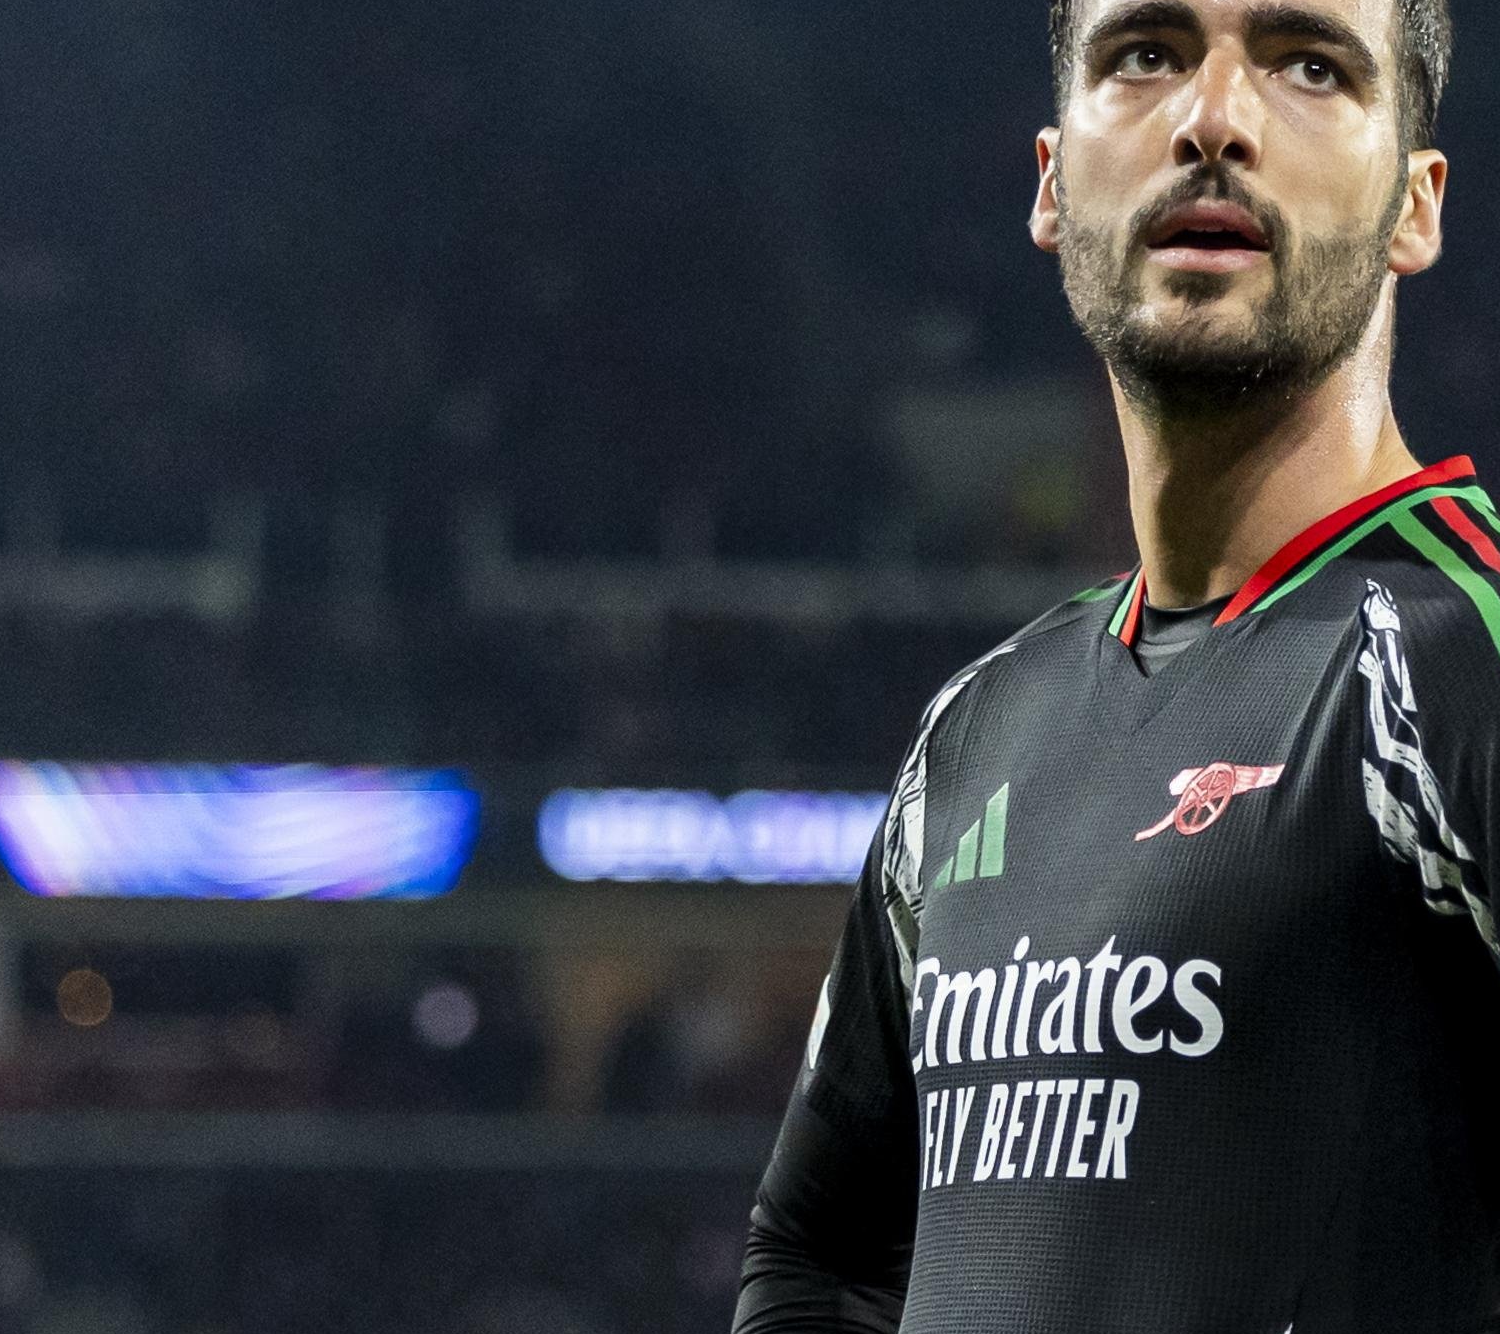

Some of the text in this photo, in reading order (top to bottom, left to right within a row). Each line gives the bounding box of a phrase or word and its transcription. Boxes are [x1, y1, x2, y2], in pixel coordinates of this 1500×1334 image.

[911, 934, 1224, 1074] Emirates
[922, 1079, 1140, 1191] FLY BETTER
